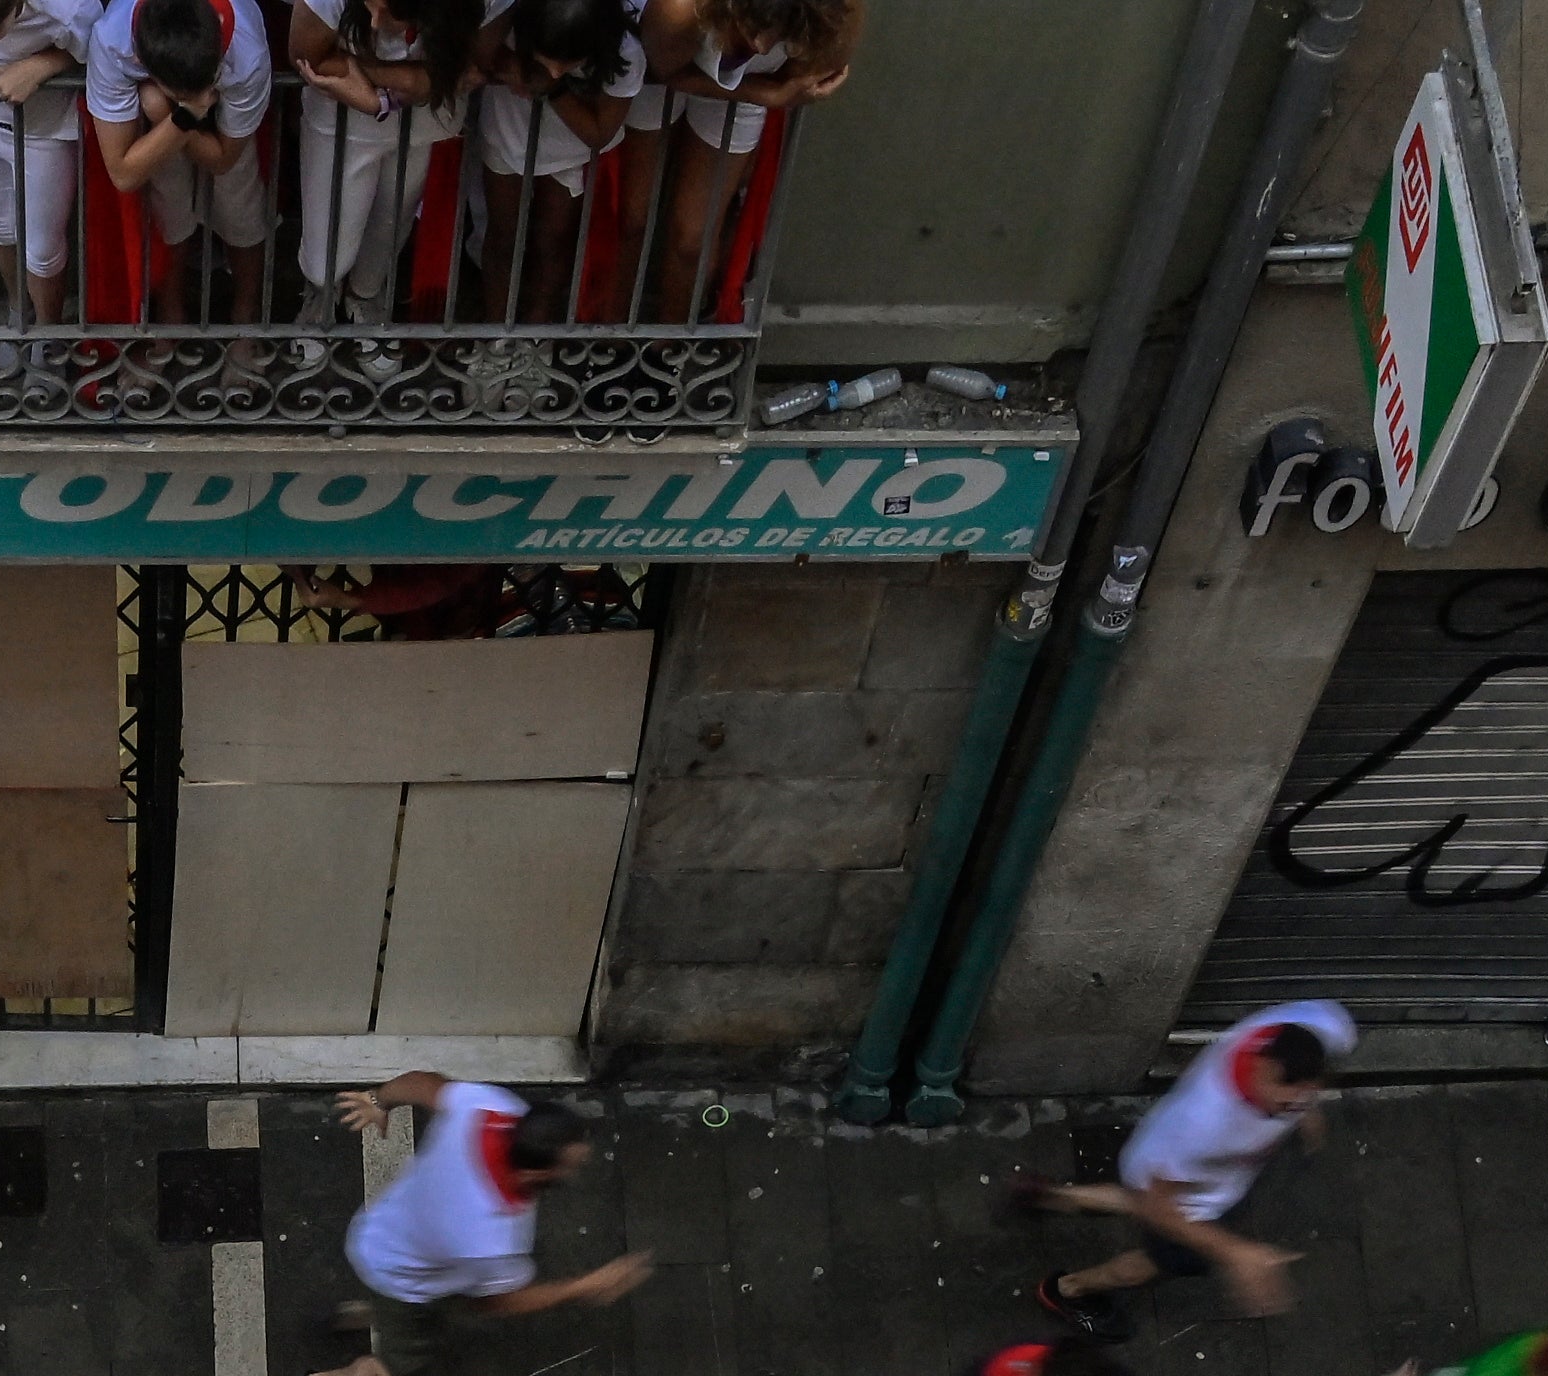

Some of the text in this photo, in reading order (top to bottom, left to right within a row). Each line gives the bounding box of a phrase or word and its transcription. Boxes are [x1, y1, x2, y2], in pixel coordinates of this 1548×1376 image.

[516, 525, 989, 550] ARTÍCULOS DE REGALO
